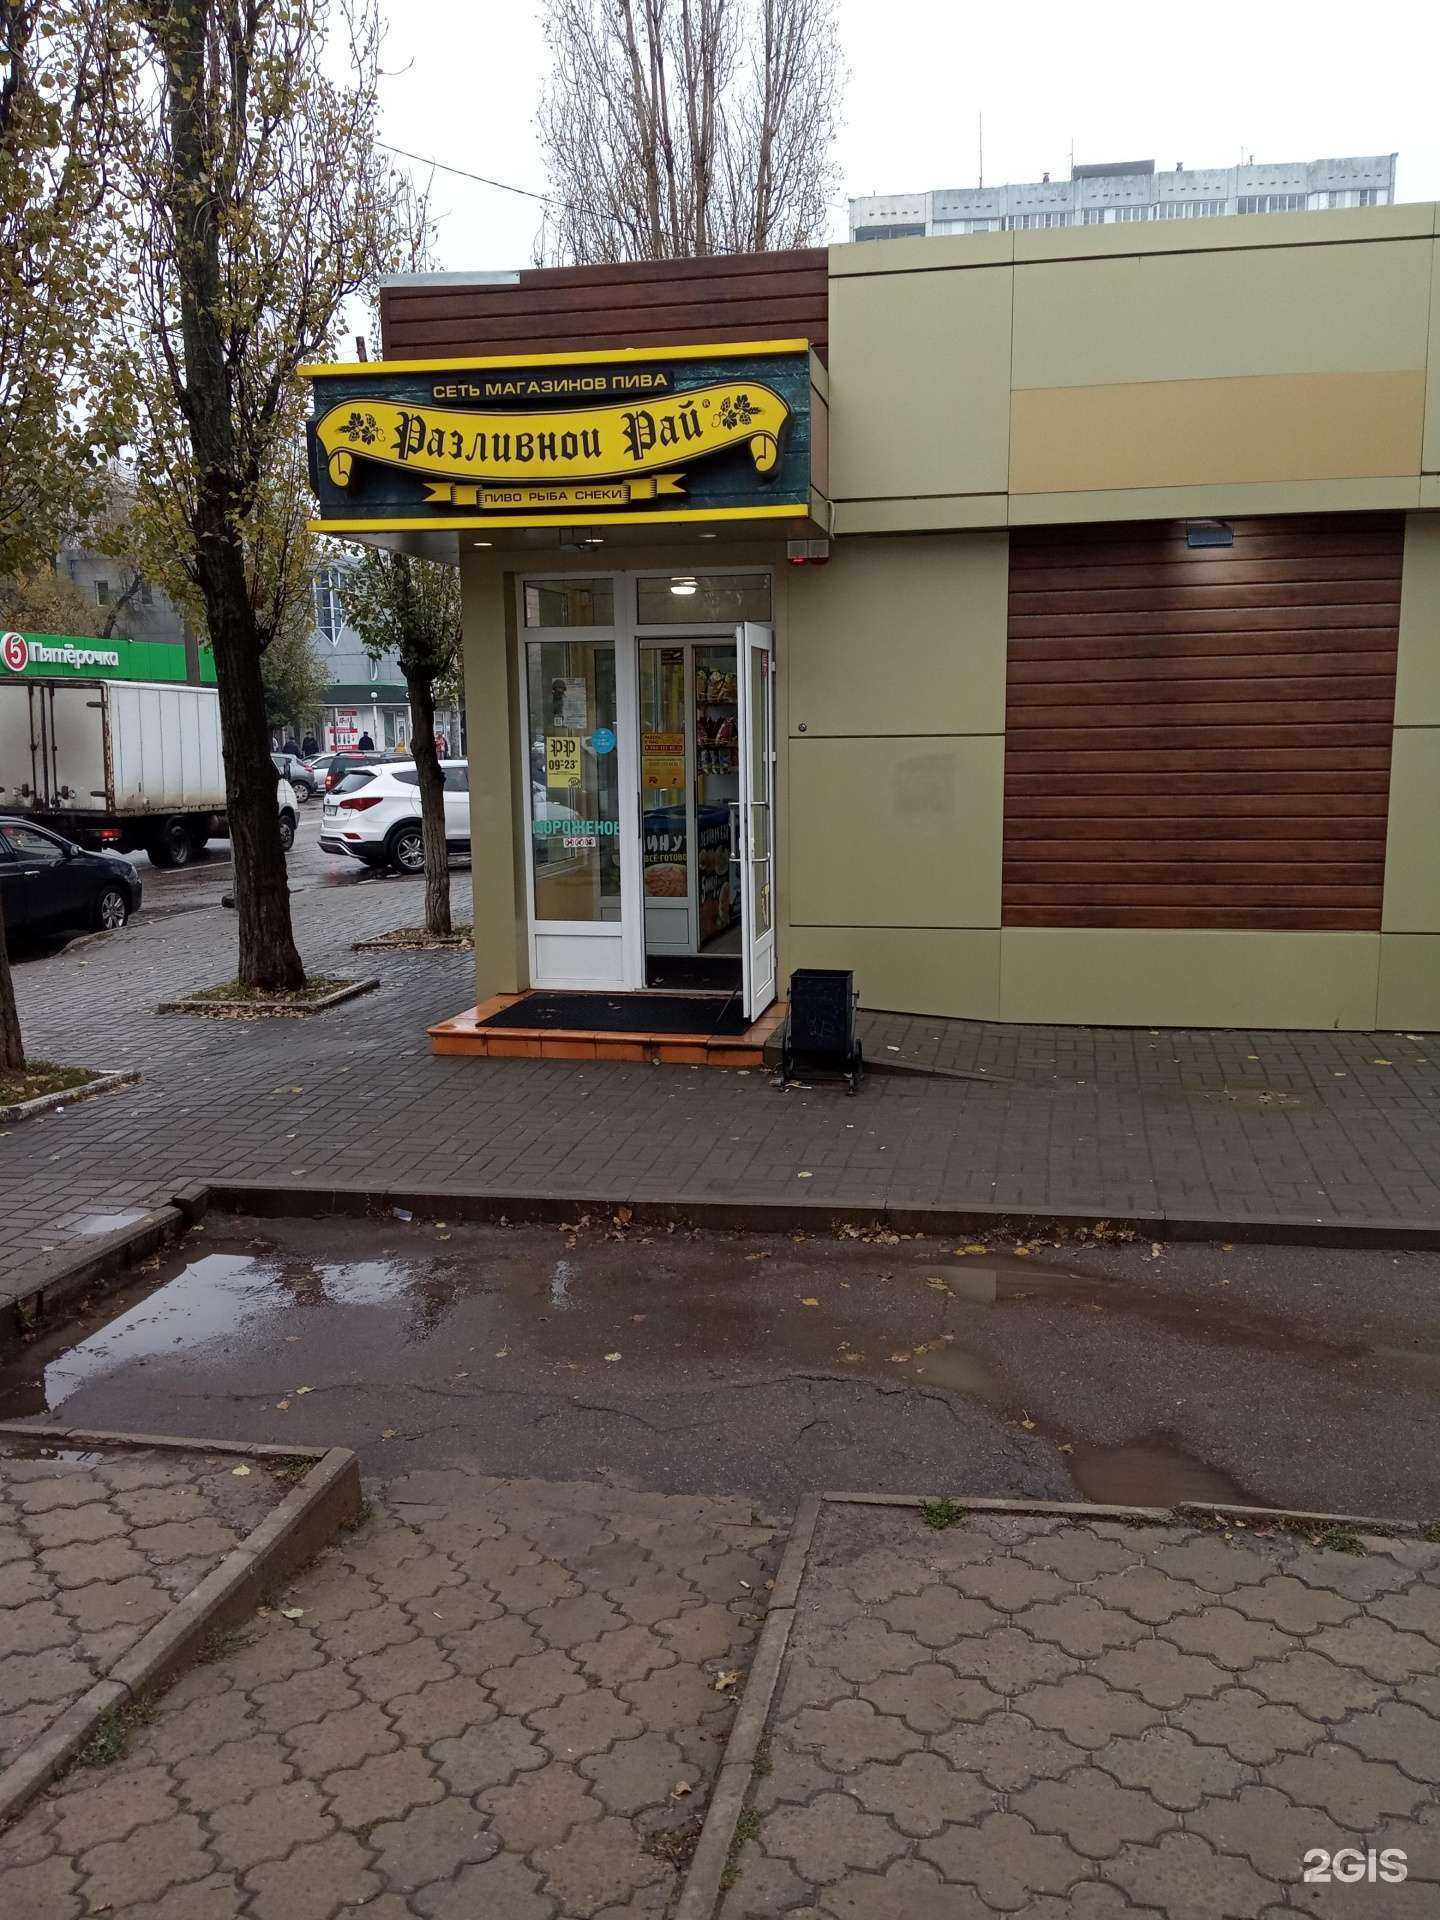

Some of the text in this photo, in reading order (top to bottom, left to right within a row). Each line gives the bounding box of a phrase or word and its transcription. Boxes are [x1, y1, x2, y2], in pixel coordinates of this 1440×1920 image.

[432, 373, 668, 399] СЕТЬ МАГАЗИНОВ ПИВА
[620, 400, 704, 461] Рай
[484, 490, 623, 503] ПИВО РЫБА СНЕКИ
[28, 641, 119, 669] Пятёрочка
